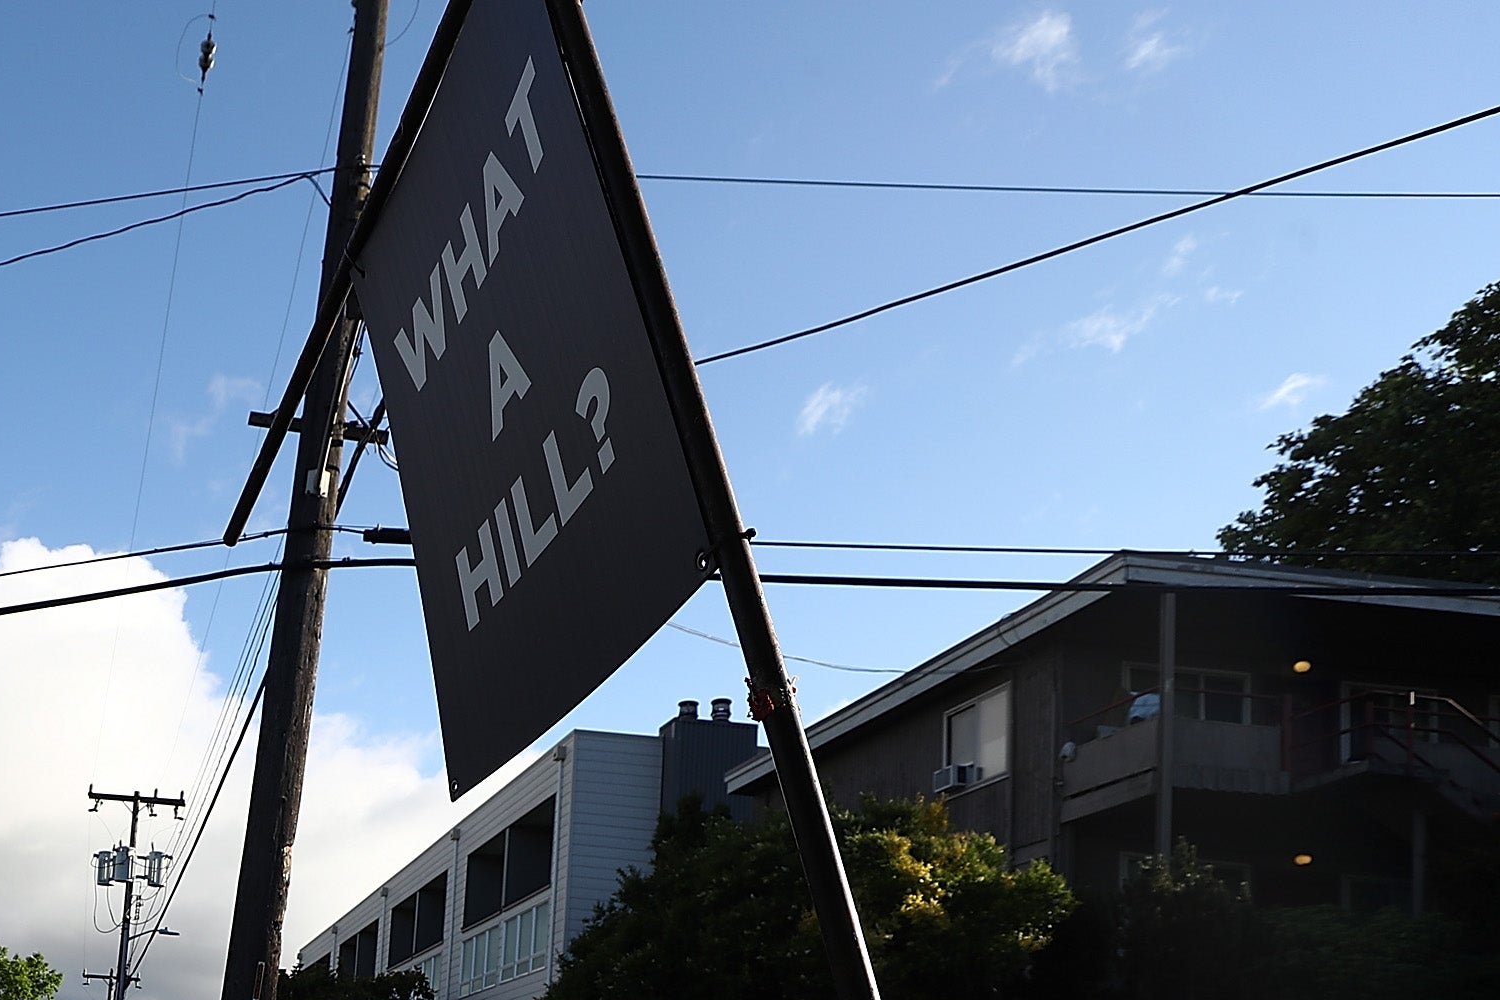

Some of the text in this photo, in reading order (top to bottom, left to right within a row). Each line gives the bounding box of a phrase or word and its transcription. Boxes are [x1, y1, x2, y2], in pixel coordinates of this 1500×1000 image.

[393, 55, 544, 392] WHAT
[454, 366, 616, 633] HILL?
[488, 329, 533, 443] A
